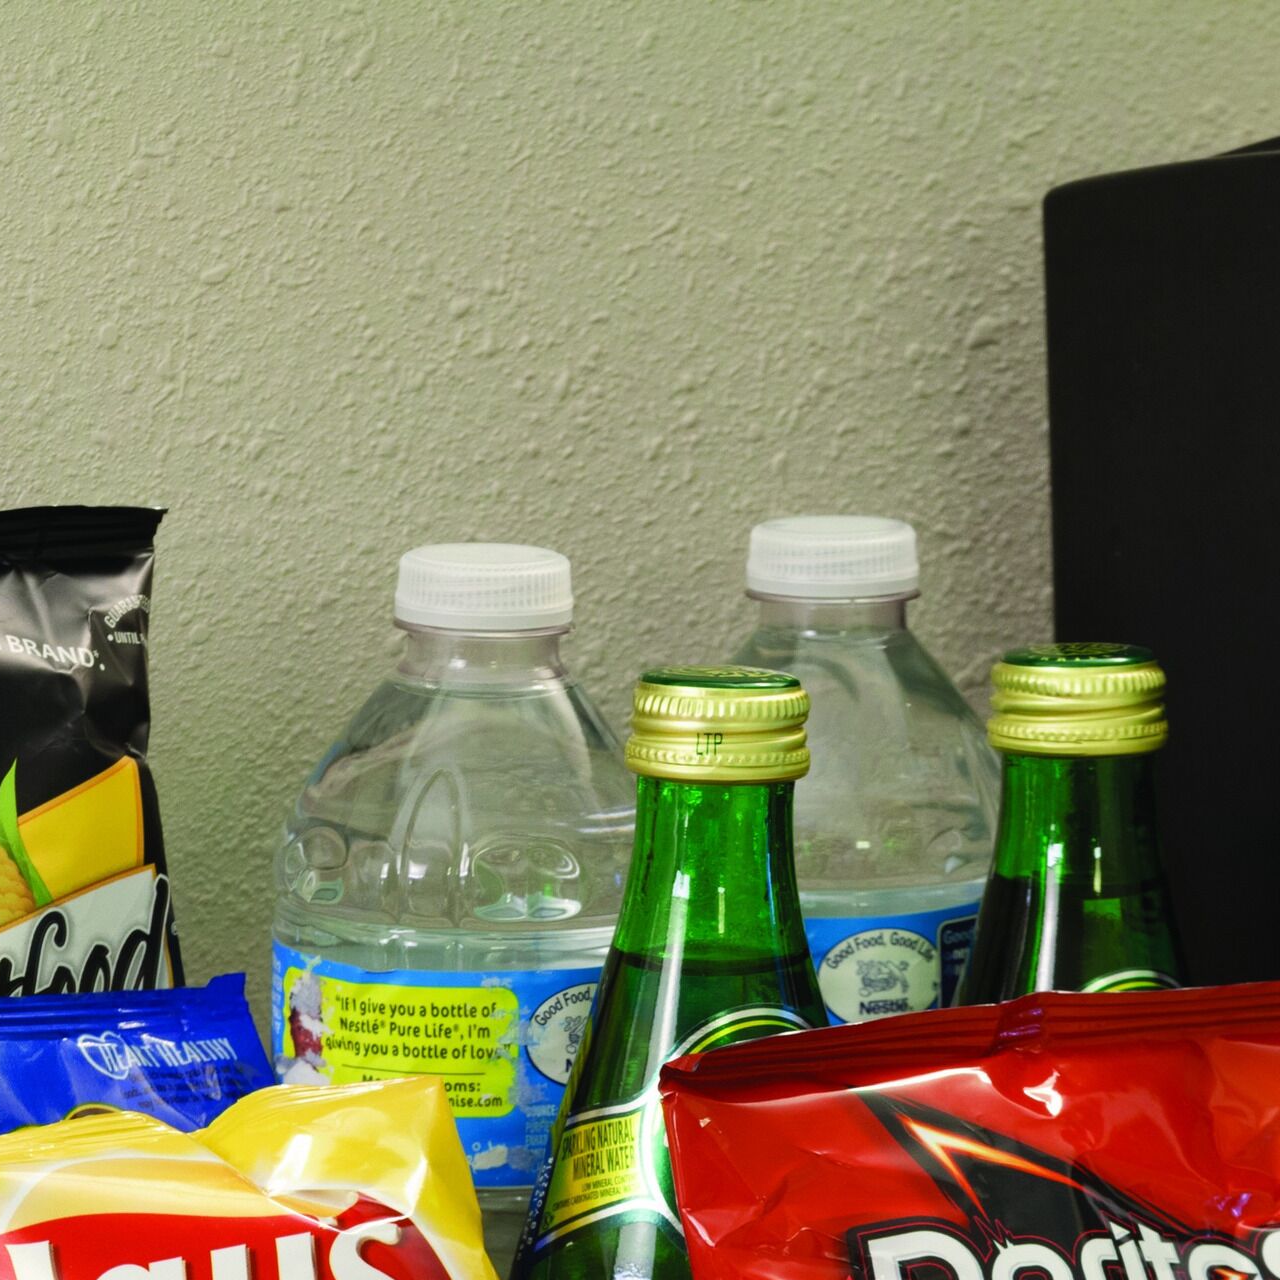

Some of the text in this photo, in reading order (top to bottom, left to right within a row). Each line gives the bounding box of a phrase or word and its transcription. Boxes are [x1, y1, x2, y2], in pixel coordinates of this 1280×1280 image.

[696, 732, 723, 756] LTP
[825, 944, 854, 970] Good
[889, 931, 919, 951] Good
[359, 998, 386, 1015] give
[389, 1003, 415, 1018] you
[419, 1006, 427, 1017] a
[431, 1002, 478, 1018] bottle
[481, 1001, 497, 1018] of
[533, 996, 564, 1027] Good
[389, 1021, 421, 1038] Pure
[468, 1025, 491, 1039] I'm
[155, 1037, 238, 1067] HEALTHY
[325, 1036, 468, 1060] giving you a bottle of
[597, 1118, 635, 1149] NATURAL
[573, 1145, 635, 1181] MINERAL WATER
